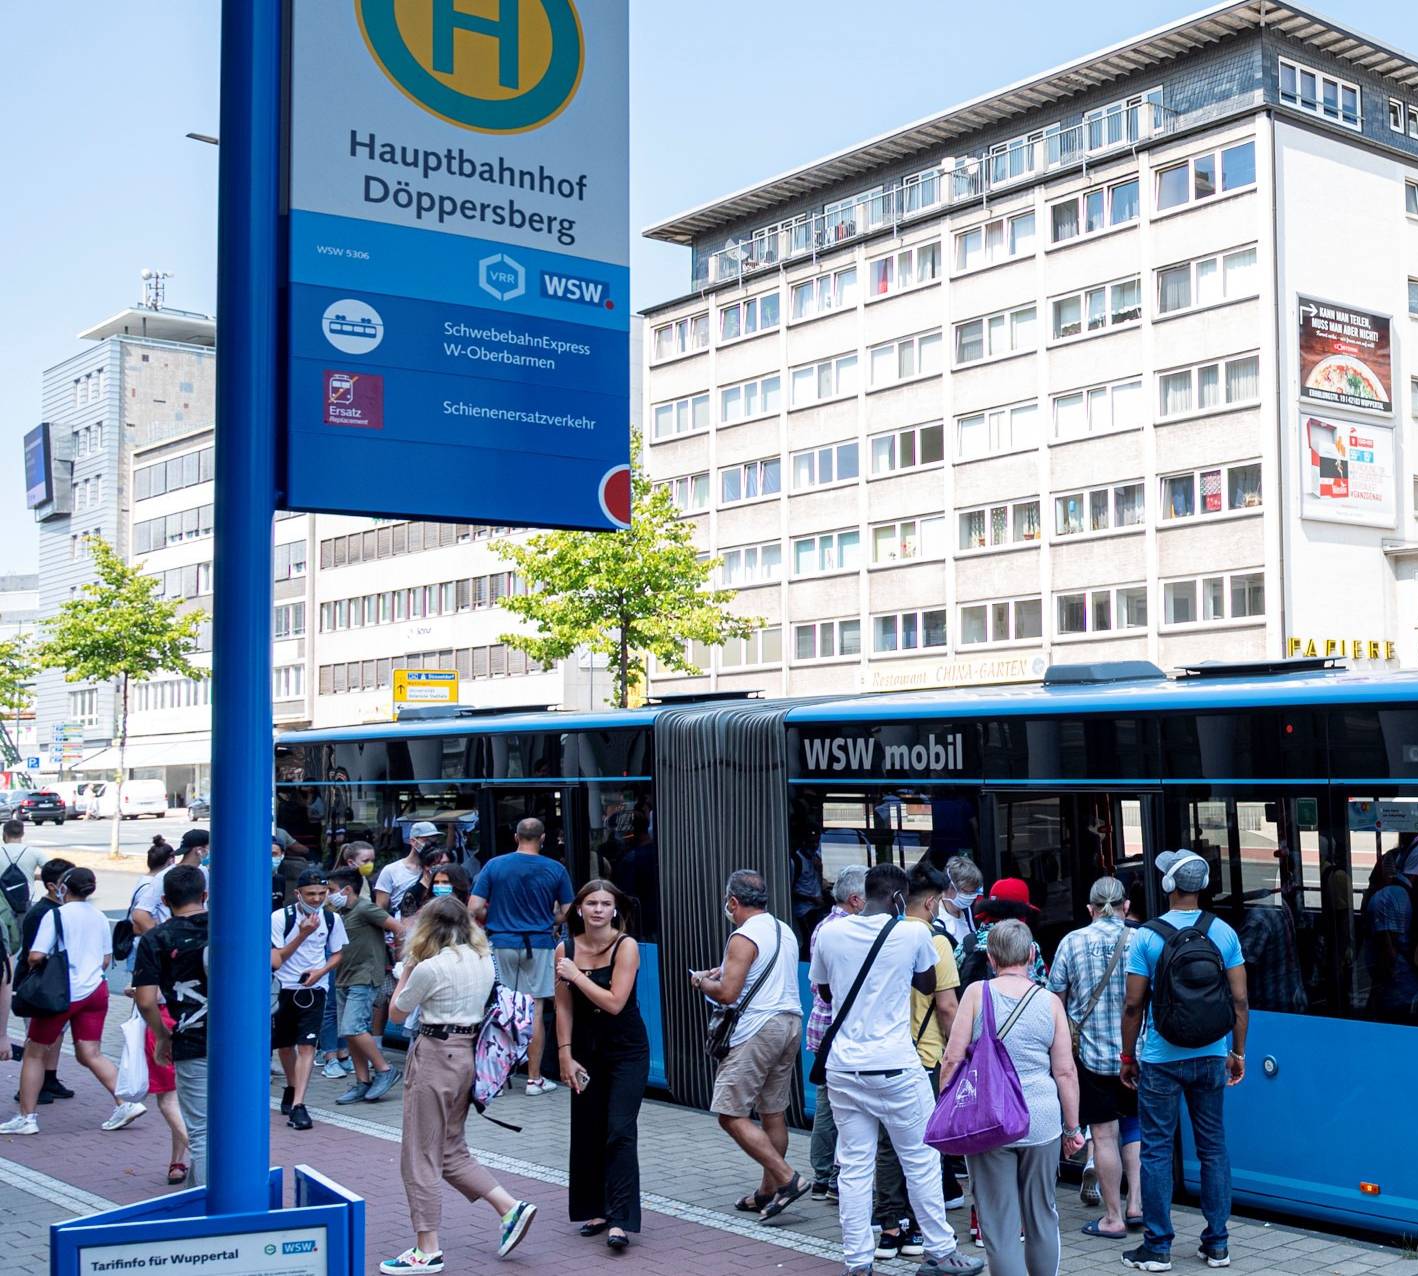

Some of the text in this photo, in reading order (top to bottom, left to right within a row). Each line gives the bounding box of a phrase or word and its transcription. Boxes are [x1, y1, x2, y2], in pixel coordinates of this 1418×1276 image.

[350, 129, 588, 201] Hauptbahnhof
[363, 174, 576, 246] Döppersberg
[316, 245, 370, 260] WSW 5306
[489, 271, 516, 284] VRR
[543, 274, 603, 304] WSW
[1319, 306, 1335, 320] KANN
[1336, 310, 1349, 323] MAN
[443, 321, 591, 356] SchwebebahnExpress
[1311, 317, 1329, 331] MUSS
[1329, 321, 1343, 334] MAN
[1343, 324, 1358, 338] ABER
[1359, 328, 1379, 343] NICHT!
[443, 343, 556, 370] W-Oberbarmen
[328, 416, 369, 426] Replacement
[329, 405, 362, 419] Ersatz
[443, 400, 597, 431] Schienenersatzverkehr
[1287, 636, 1396, 661] PAPIERE
[935, 658, 1028, 684] CHINA-GARTEN
[804, 733, 963, 771] WSW mobil
[91, 1248, 239, 1272] Tarifinfo für Wuppertal
[284, 1242, 312, 1253] WSW
